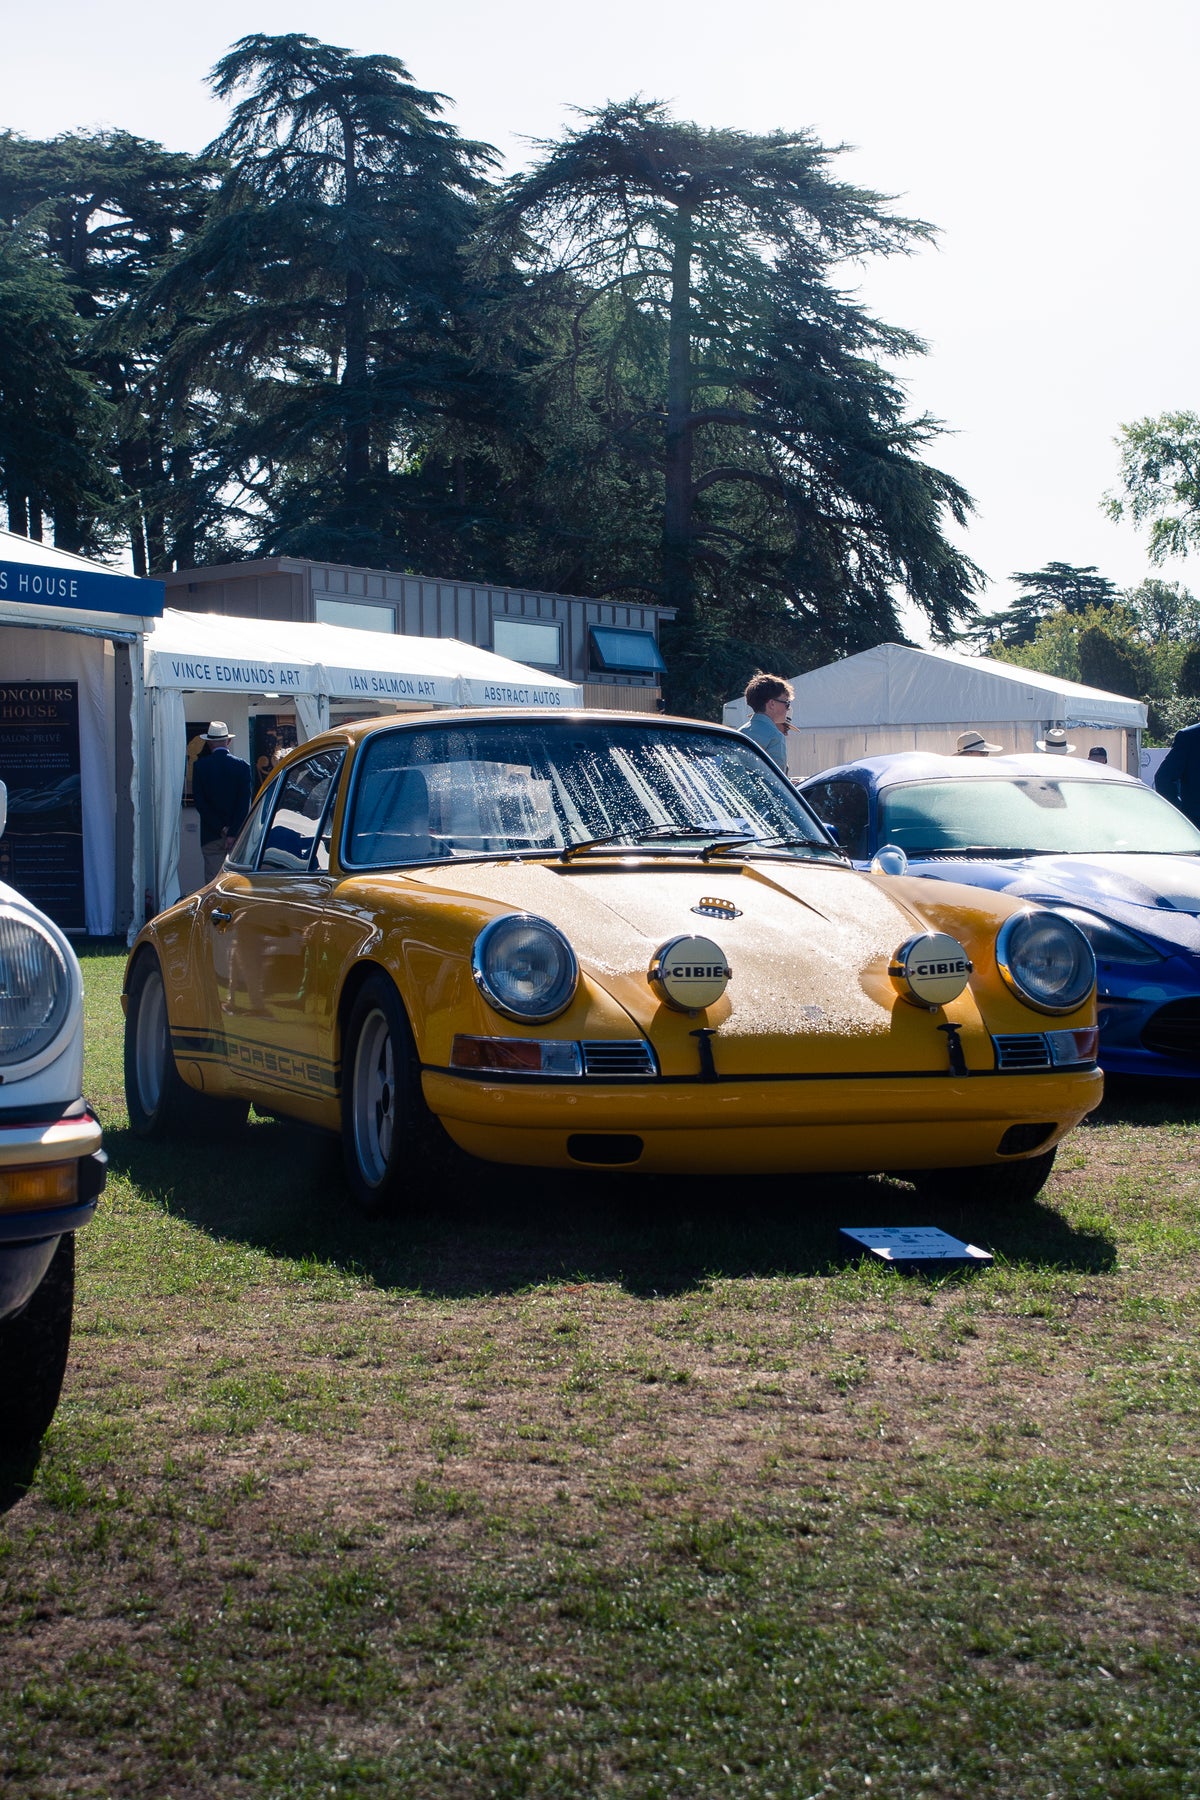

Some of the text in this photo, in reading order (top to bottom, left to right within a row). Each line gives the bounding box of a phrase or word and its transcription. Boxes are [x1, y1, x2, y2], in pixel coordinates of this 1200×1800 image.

[19, 574, 78, 598] HOUSE
[172, 661, 300, 686] VINCE EDMUNDS ART
[349, 675, 436, 696] IAN SALMON ART
[484, 686, 561, 706] ABSTRACT AUTOS
[3, 704, 57, 719] HOUSE
[228, 1042, 320, 1083] PORSCHE
